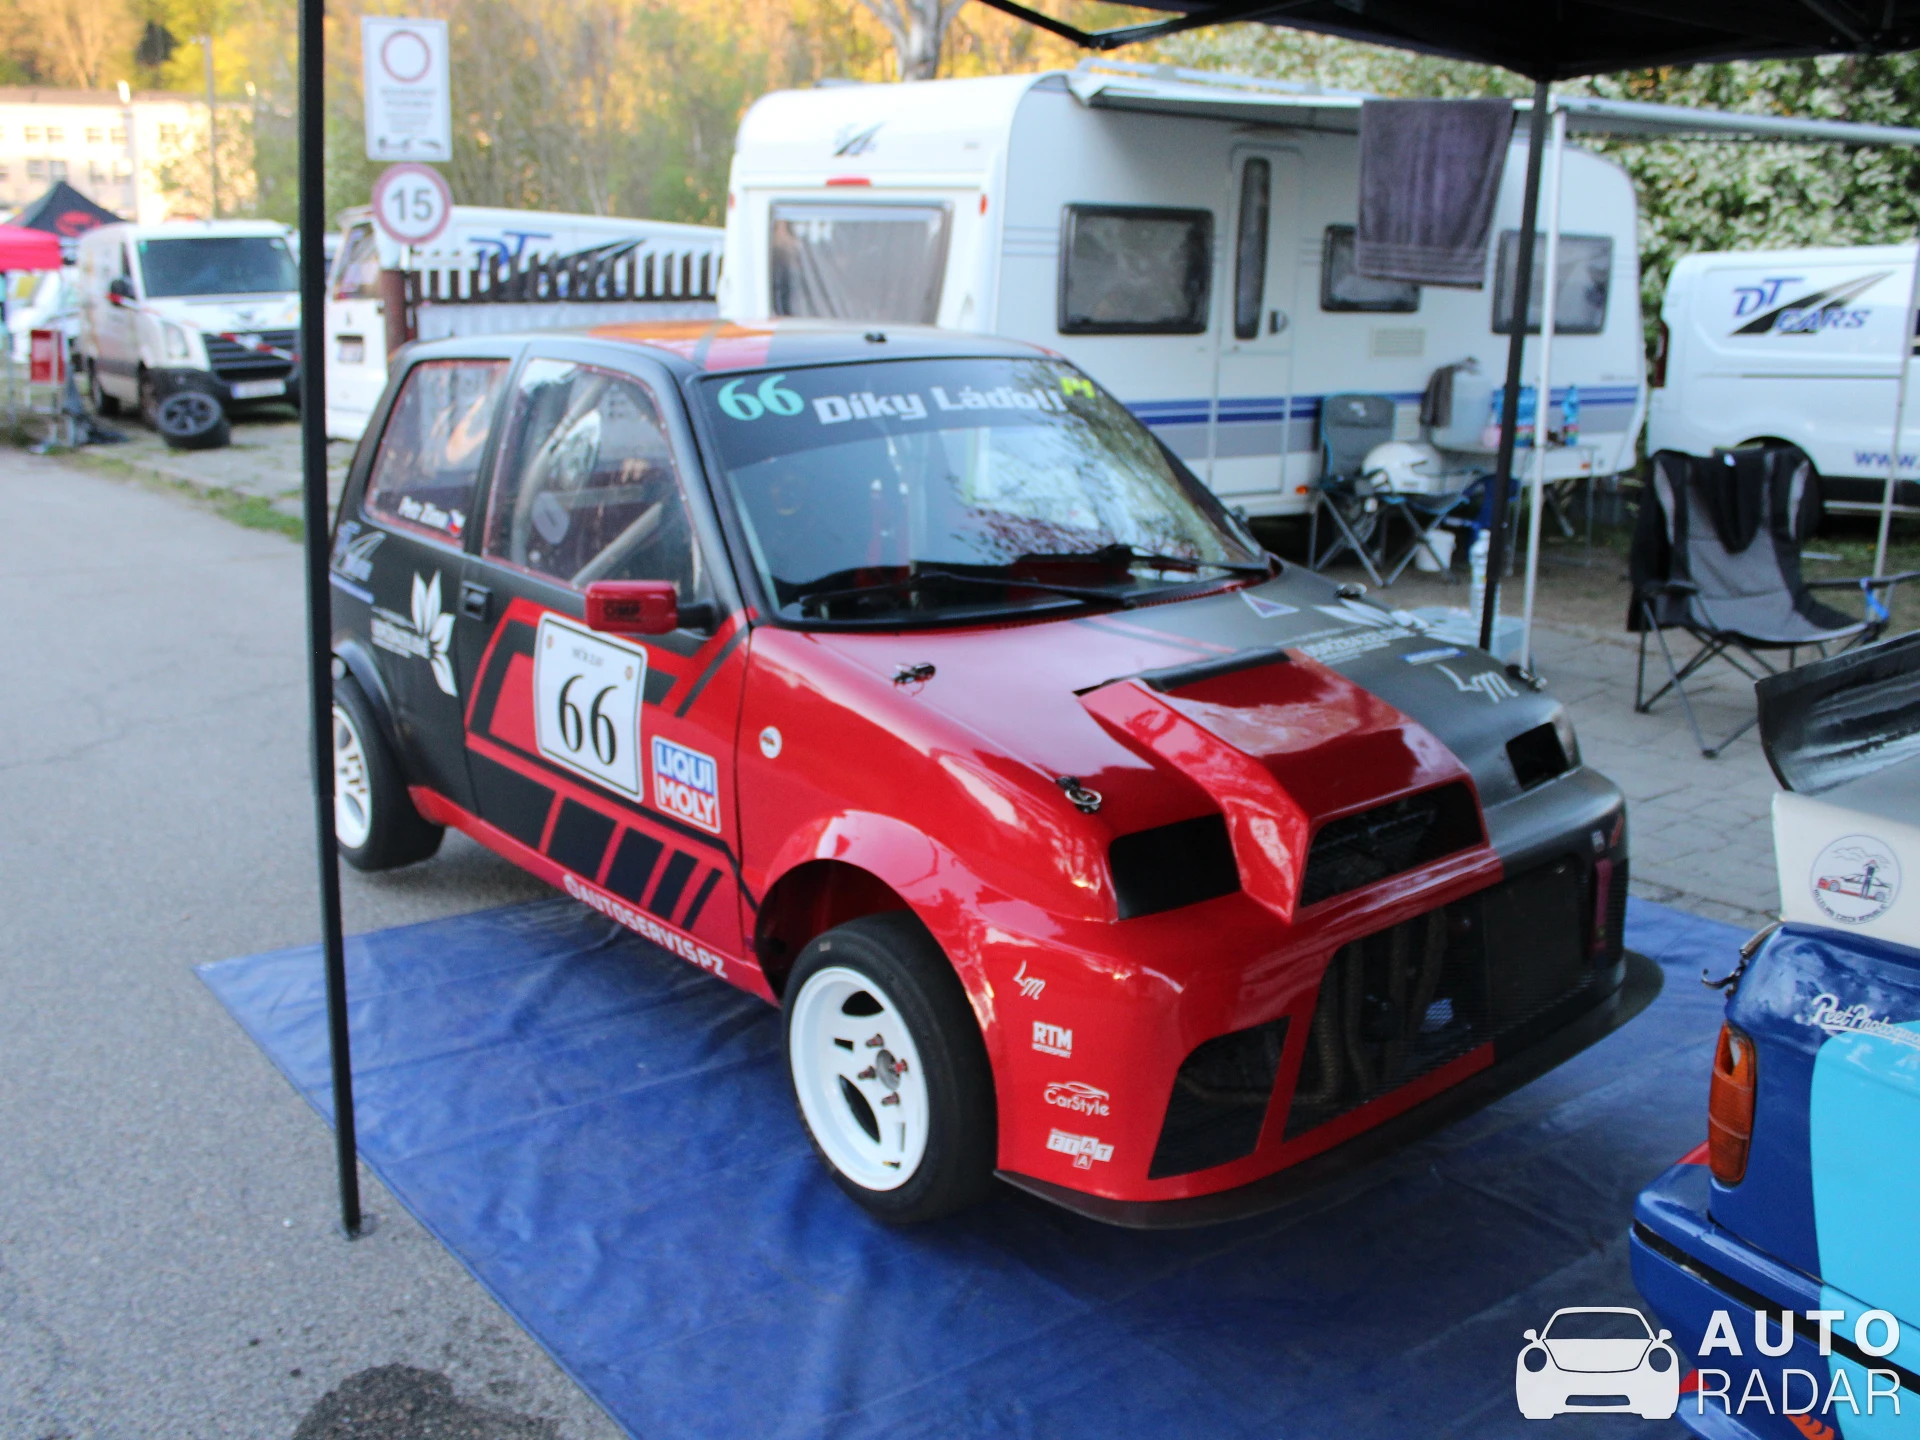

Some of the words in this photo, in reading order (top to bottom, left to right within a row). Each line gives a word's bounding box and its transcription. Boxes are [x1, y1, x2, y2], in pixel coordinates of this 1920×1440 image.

[390, 188, 433, 222] 15
[1733, 275, 1804, 317] DT
[1774, 307, 1872, 333] CARS
[717, 374, 804, 421] 66
[812, 391, 929, 425] Díky
[558, 674, 618, 766] 66
[656, 742, 714, 793] LIQUI
[658, 778, 716, 825] MOLY
[1033, 1020, 1073, 1051] RTM
[1044, 1088, 1110, 1117] CarStyle
[1050, 1134, 1111, 1159] FIAT
